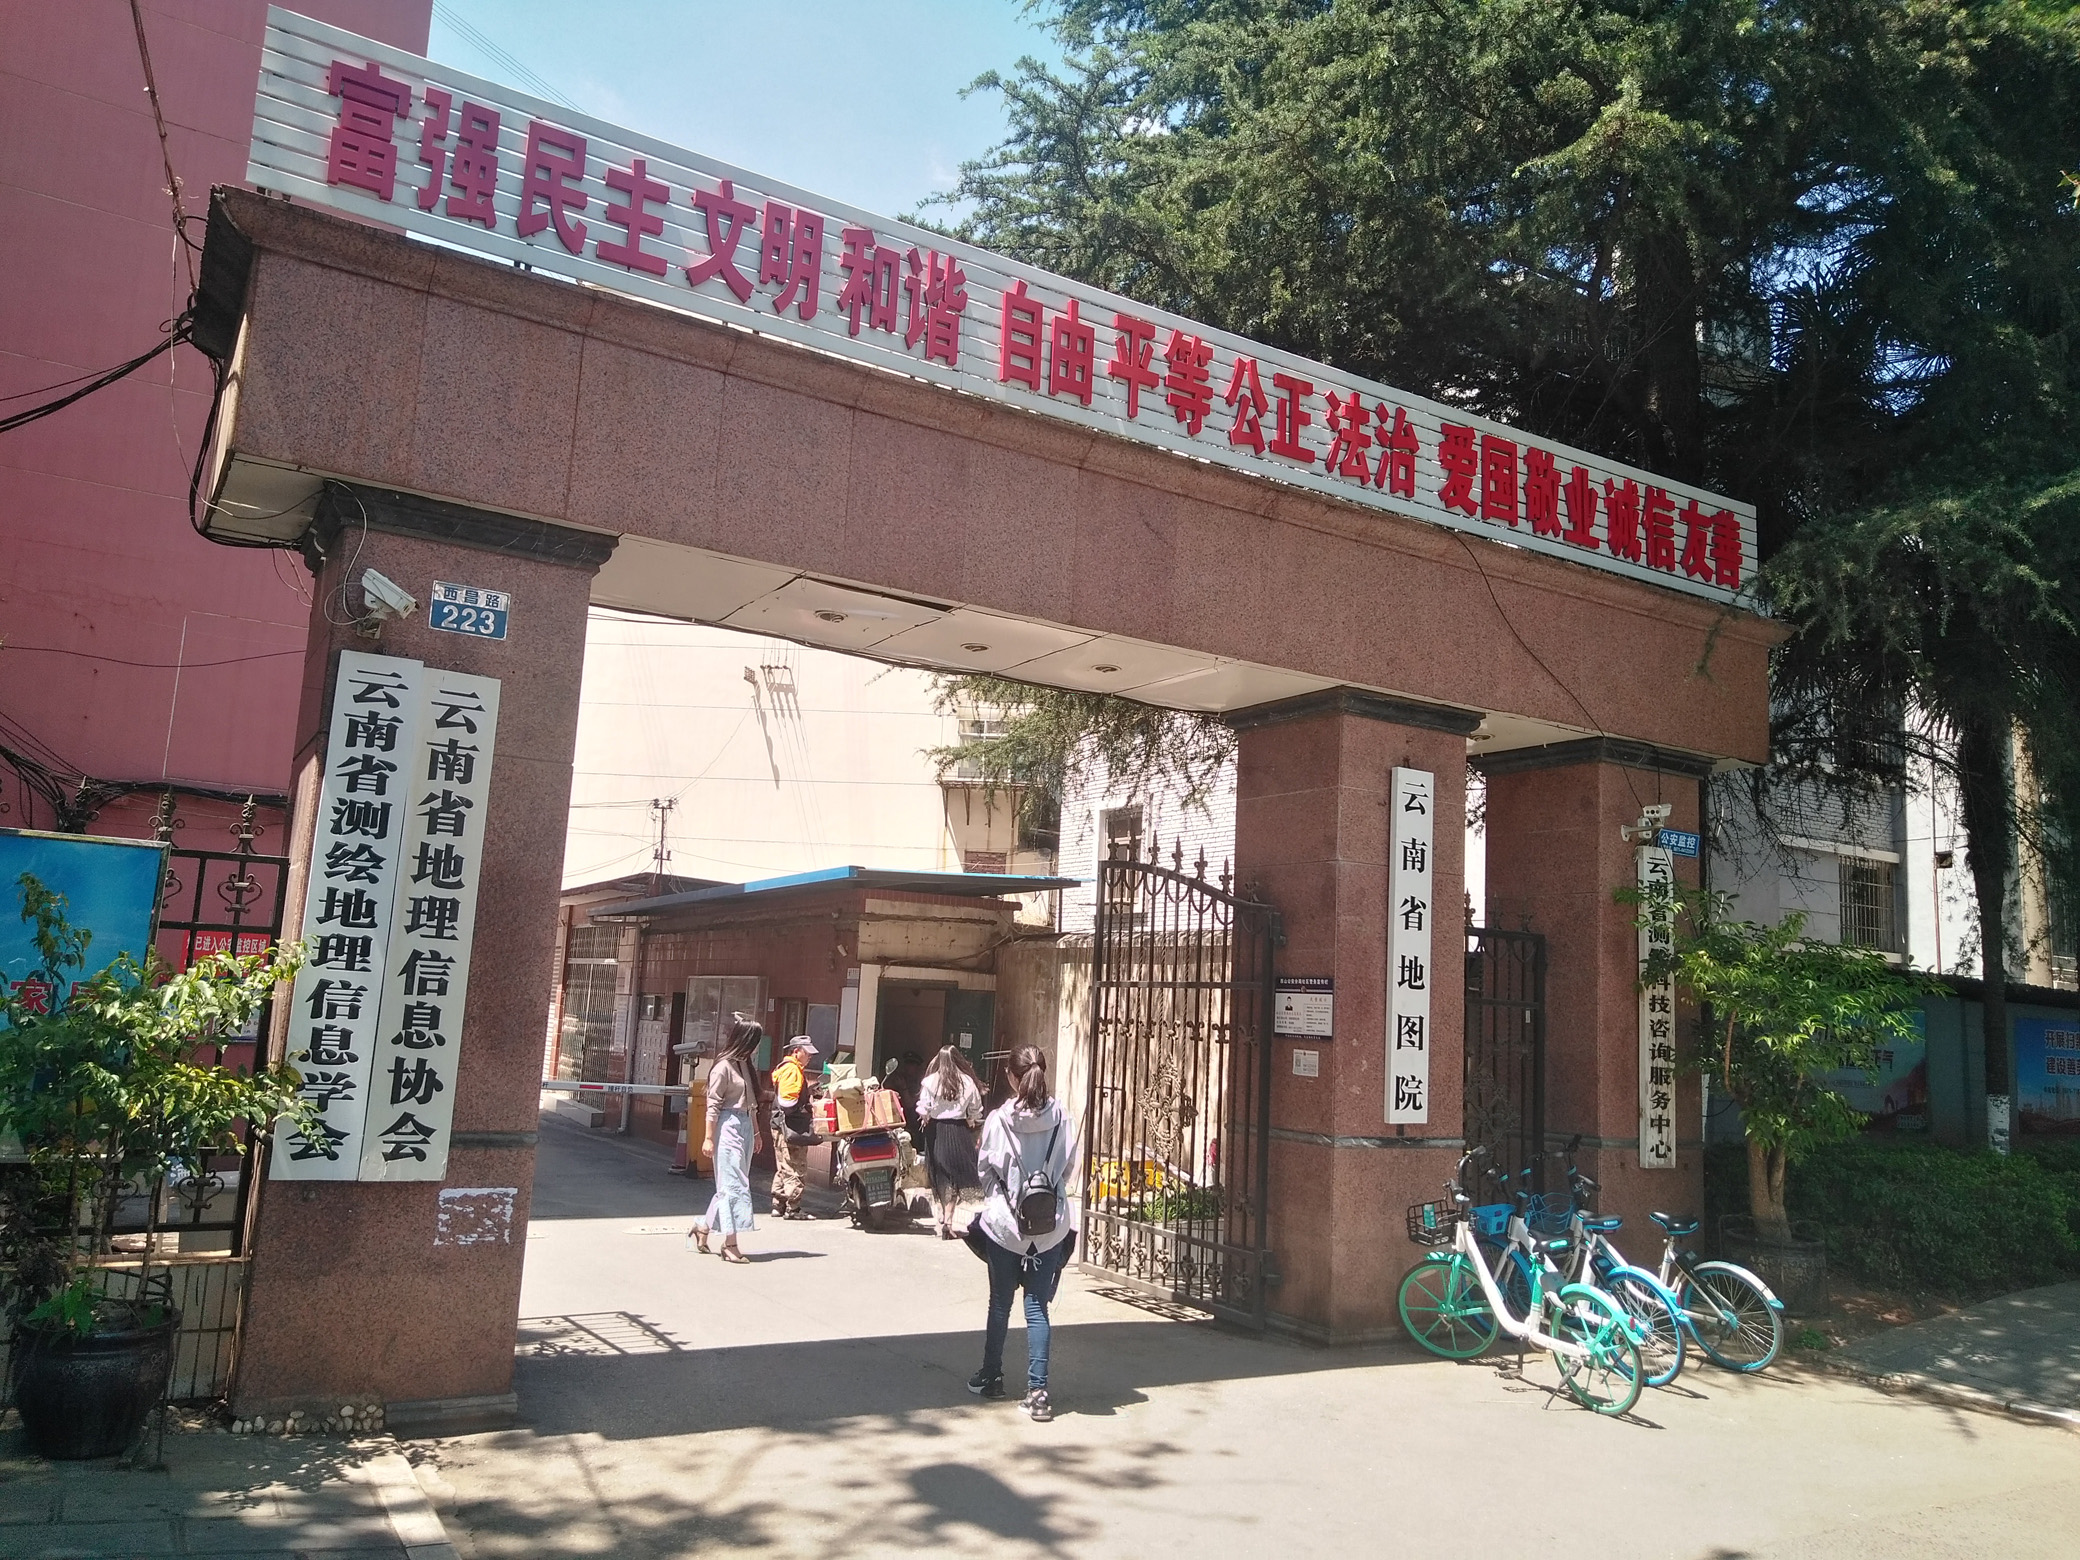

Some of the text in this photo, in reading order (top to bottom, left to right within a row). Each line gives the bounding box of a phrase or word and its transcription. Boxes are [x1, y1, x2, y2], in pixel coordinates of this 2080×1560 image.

[326, 60, 1743, 590] 富强民主文明和谐 自由平等公正法治 爱国敬业诚信友善
[441, 604, 495, 634] 223
[443, 586, 500, 608] 西昌路
[186, 934, 267, 954] 已进入公安监控区域
[285, 669, 409, 1161] 云南省测绘地理信息学会
[378, 688, 486, 1162] 云南省地理信息协会
[1394, 782, 1429, 1114] 云南省地图院
[1660, 832, 1696, 849] 公安监控
[1647, 856, 1672, 1159] 云南省测科技咨询服务中心
